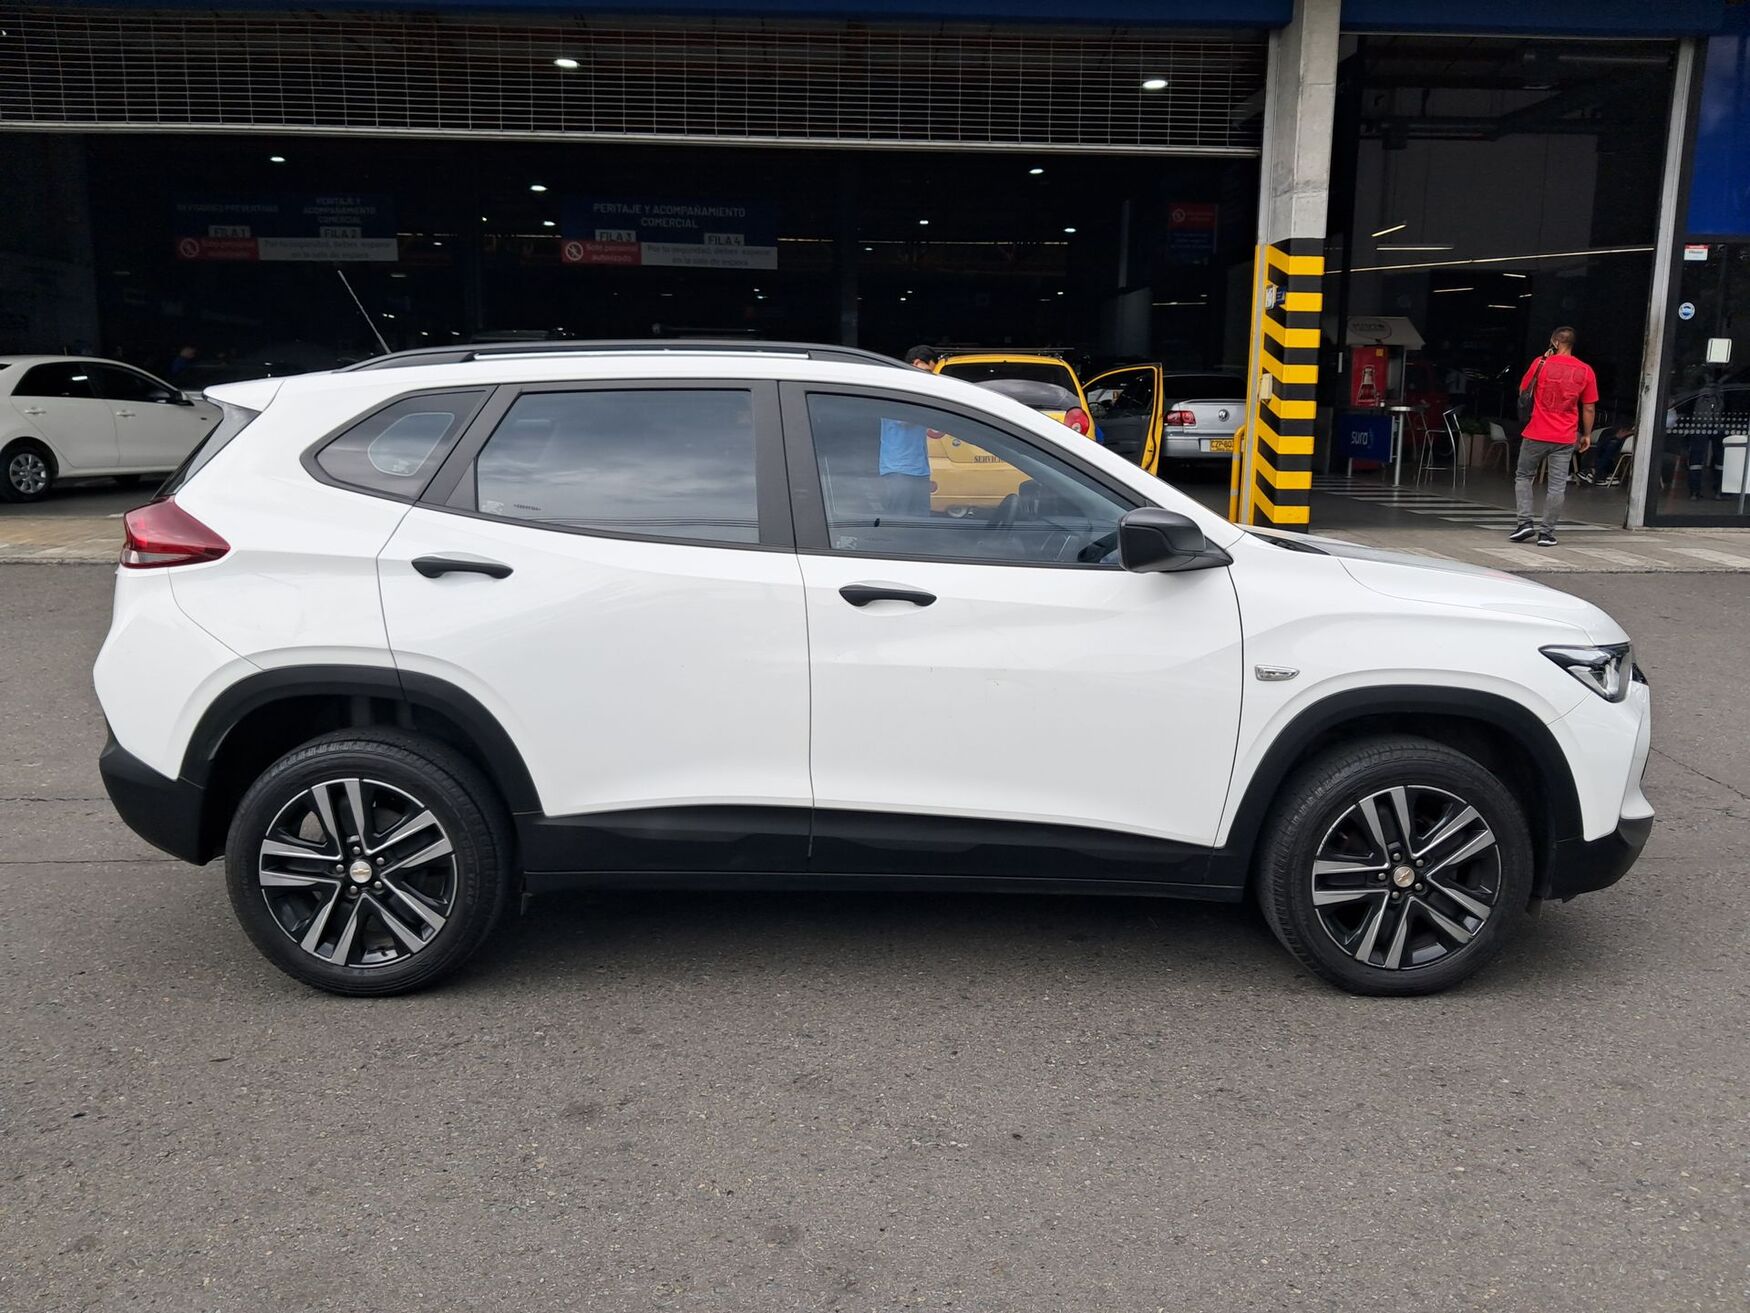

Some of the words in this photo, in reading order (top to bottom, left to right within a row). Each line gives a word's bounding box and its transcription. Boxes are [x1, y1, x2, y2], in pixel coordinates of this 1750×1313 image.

[592, 202, 642, 214] PERITAJE
[653, 203, 746, 217] ACOMPAÑAMIENTO
[640, 217, 699, 229] COMERCIAL
[600, 231, 623, 241] FILA
[708, 235, 732, 245] FILA
[1350, 431, 1368, 445] sura
[974, 455, 1002, 463] SERVICI
